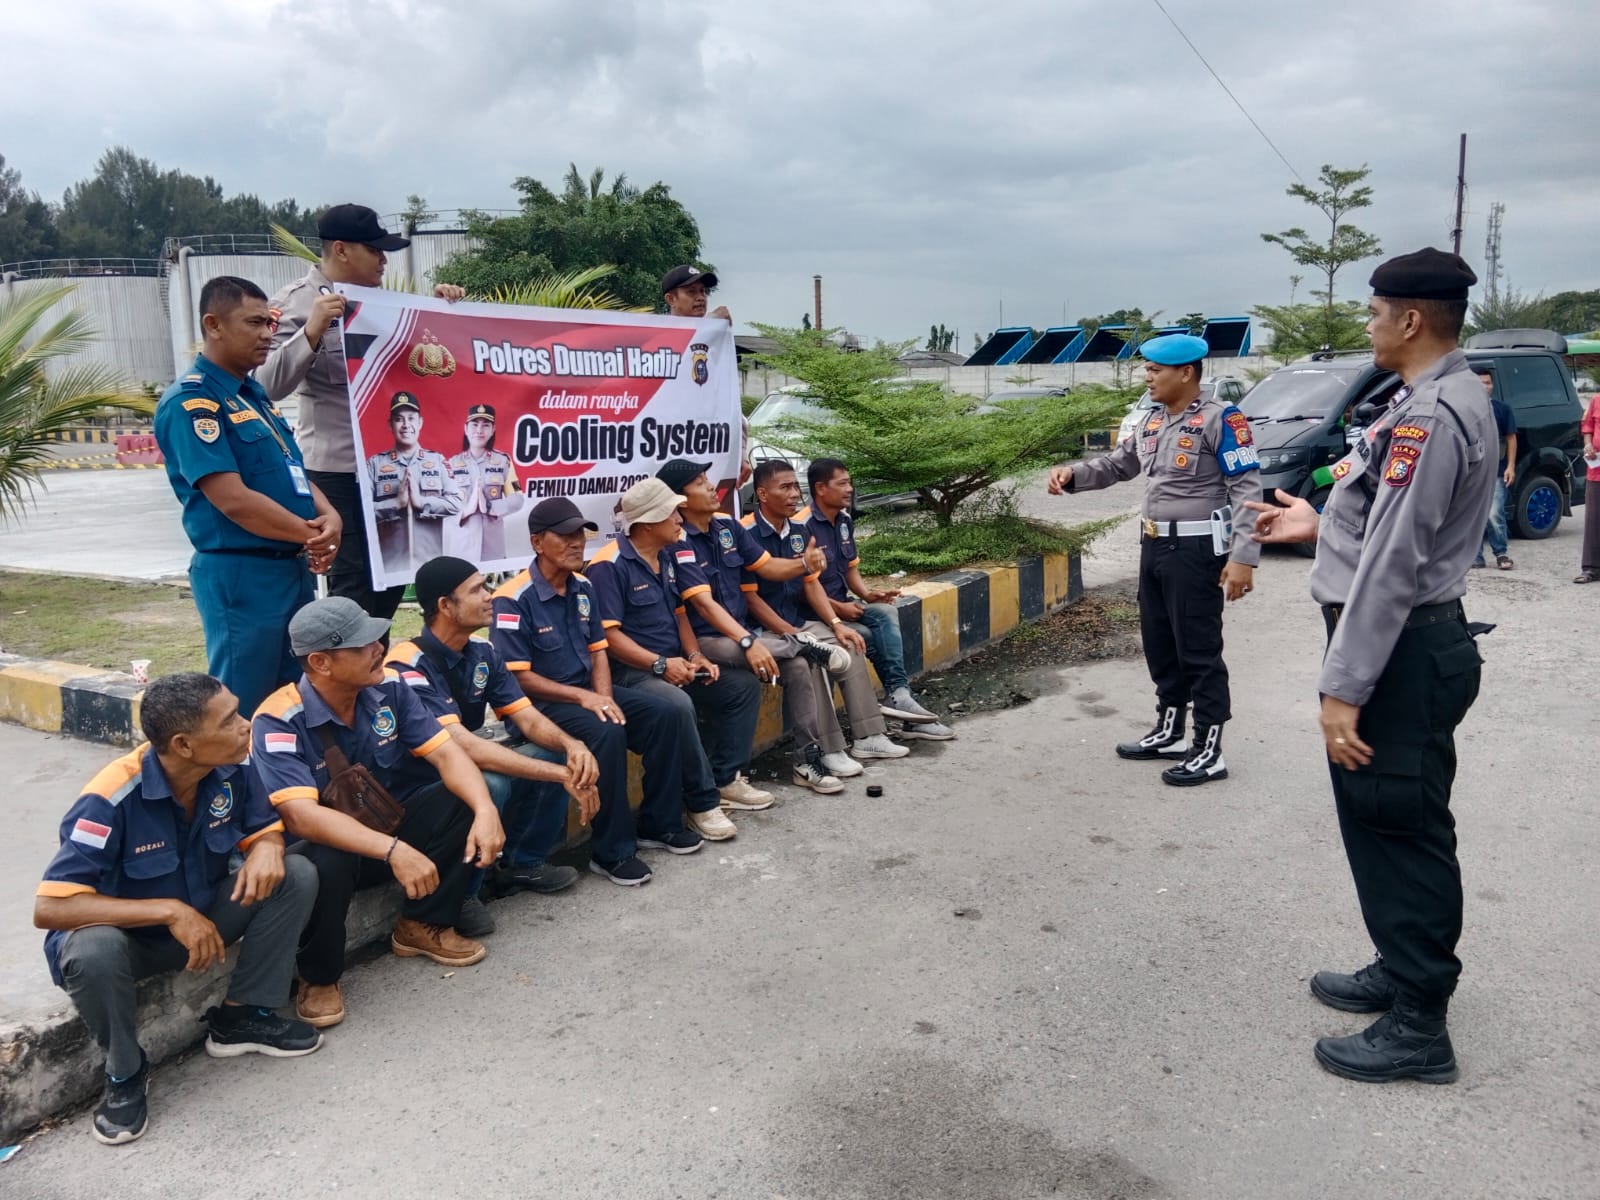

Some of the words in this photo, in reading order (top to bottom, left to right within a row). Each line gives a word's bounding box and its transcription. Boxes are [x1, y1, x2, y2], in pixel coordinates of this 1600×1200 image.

[472, 339, 551, 376] Polres
[552, 343, 625, 379] Dumai
[626, 346, 681, 379] Hadir
[539, 390, 588, 409] dalam
[589, 391, 639, 415] rangka
[516, 417, 636, 464] Cooling
[640, 416, 730, 461] System
[1393, 446, 1417, 455] RIAU
[528, 479, 577, 498] PEMILU
[578, 476, 619, 496] DAMAI
[620, 474, 649, 493] 20
[135, 840, 165, 854] ROZALI
